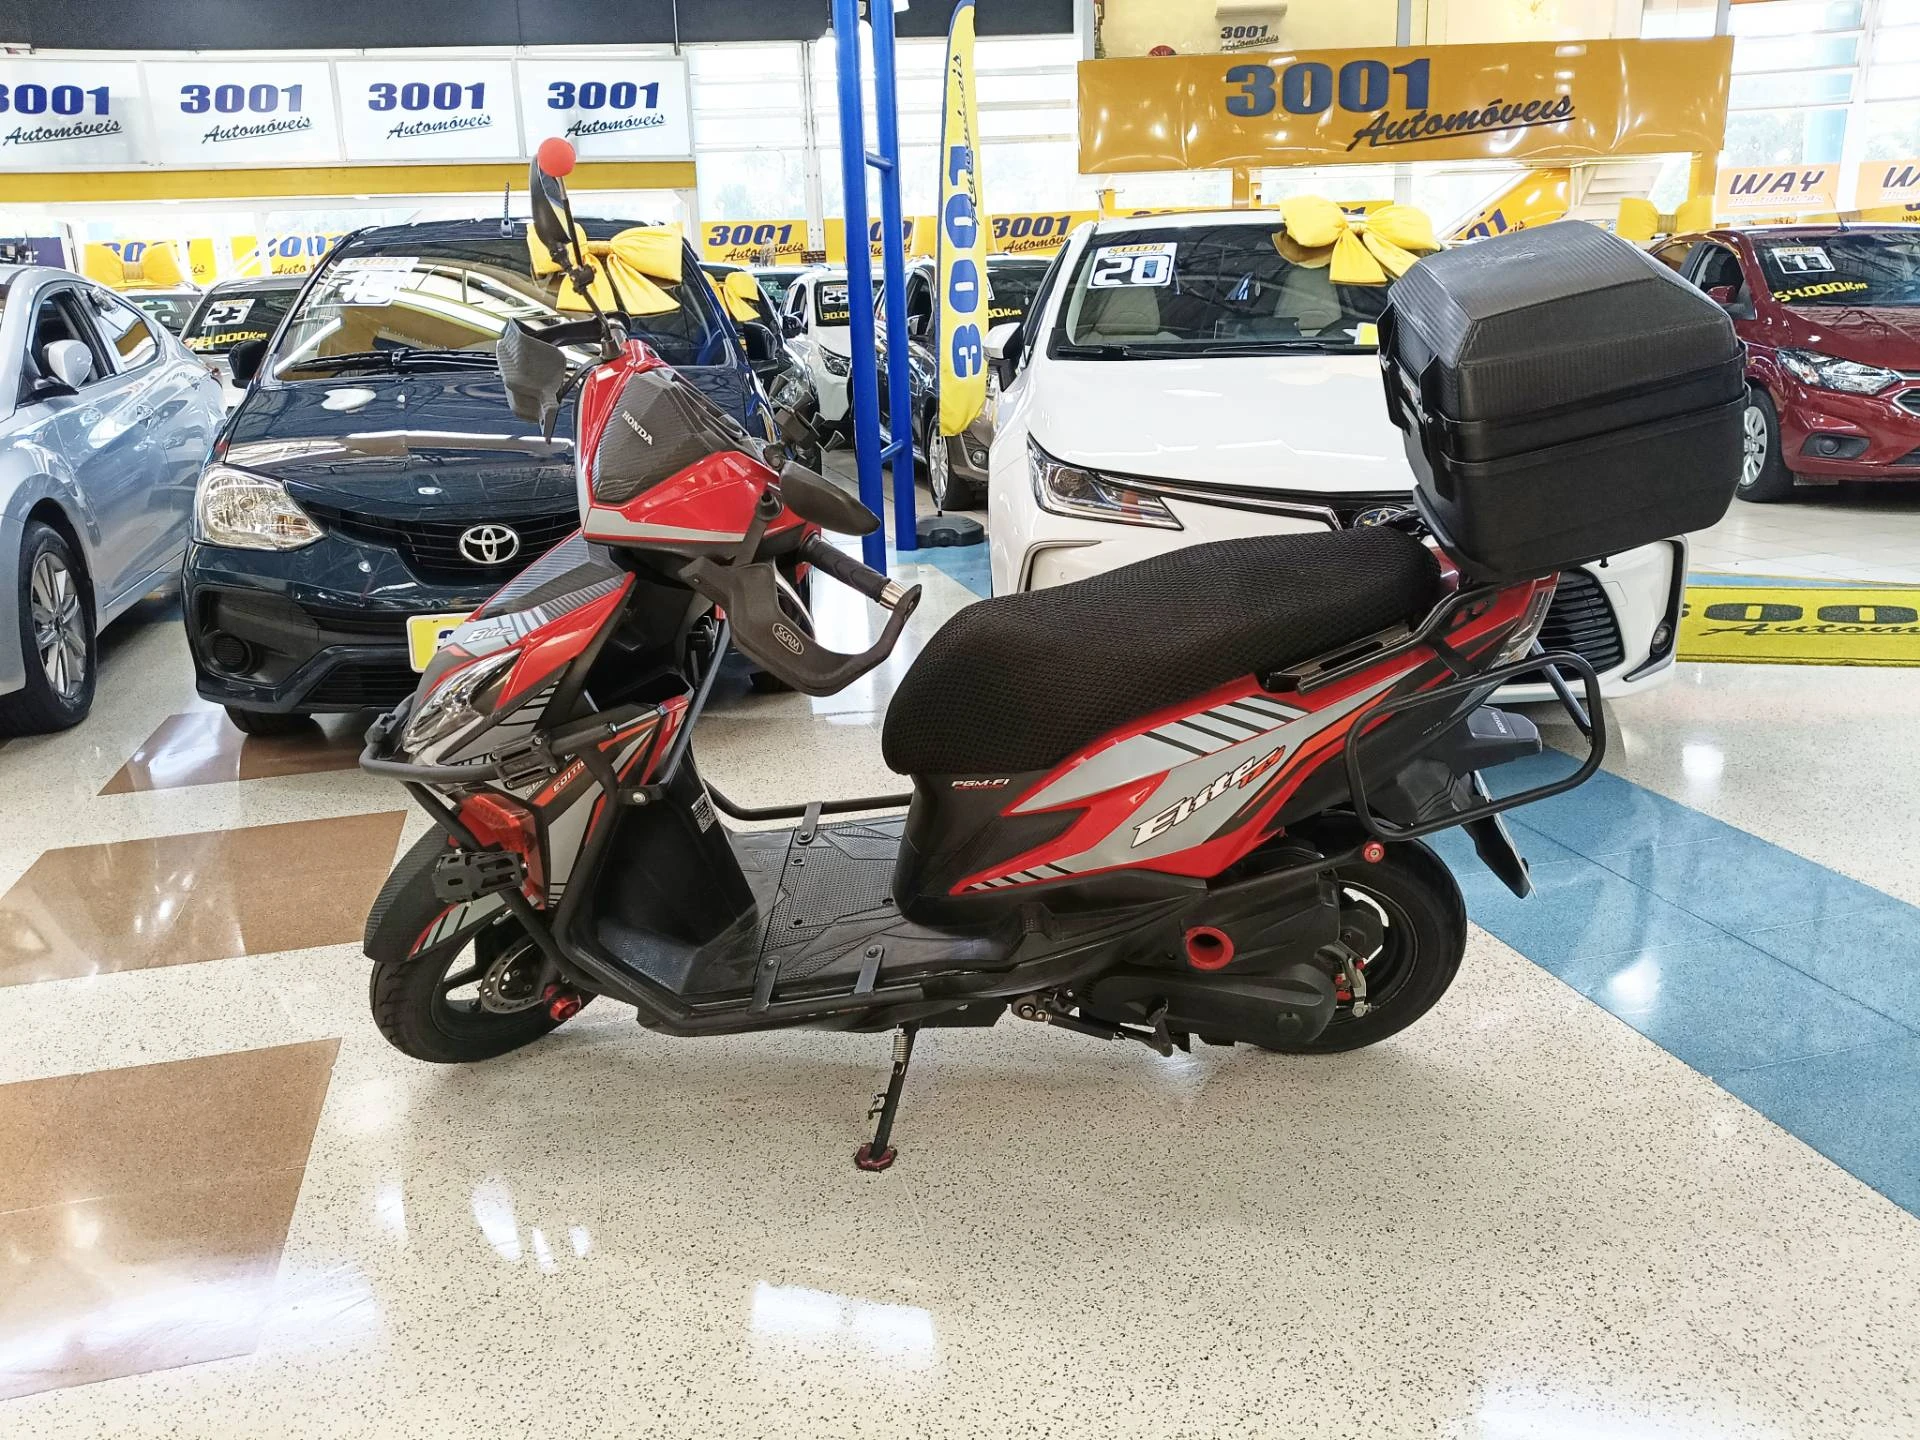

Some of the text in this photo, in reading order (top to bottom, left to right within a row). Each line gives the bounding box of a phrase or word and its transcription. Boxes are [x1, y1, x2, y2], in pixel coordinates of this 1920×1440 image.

[1220, 25, 1268, 39] 3001
[180, 84, 303, 113] 3001
[368, 82, 486, 111] 3001
[547, 81, 660, 109] 3001
[1225, 58, 1431, 117] 3001
[2, 118, 123, 145] Automóveis
[202, 116, 313, 144] Automóveis
[387, 112, 493, 139] Automóveis
[565, 112, 667, 137] Automóveis
[1346, 95, 1576, 151] Automóveis
[1729, 170, 1825, 195] WAY
[708, 224, 793, 246] 3001
[992, 216, 1071, 238] 3001
[944, 145, 983, 378] 3001
[1093, 256, 1170, 285] 20
[1774, 282, 1869, 302] 54.000Km
[207, 308, 247, 324] 23
[622, 410, 653, 446] HONDA
[1681, 603, 1919, 624] 00
[1131, 745, 1280, 848] Elite
